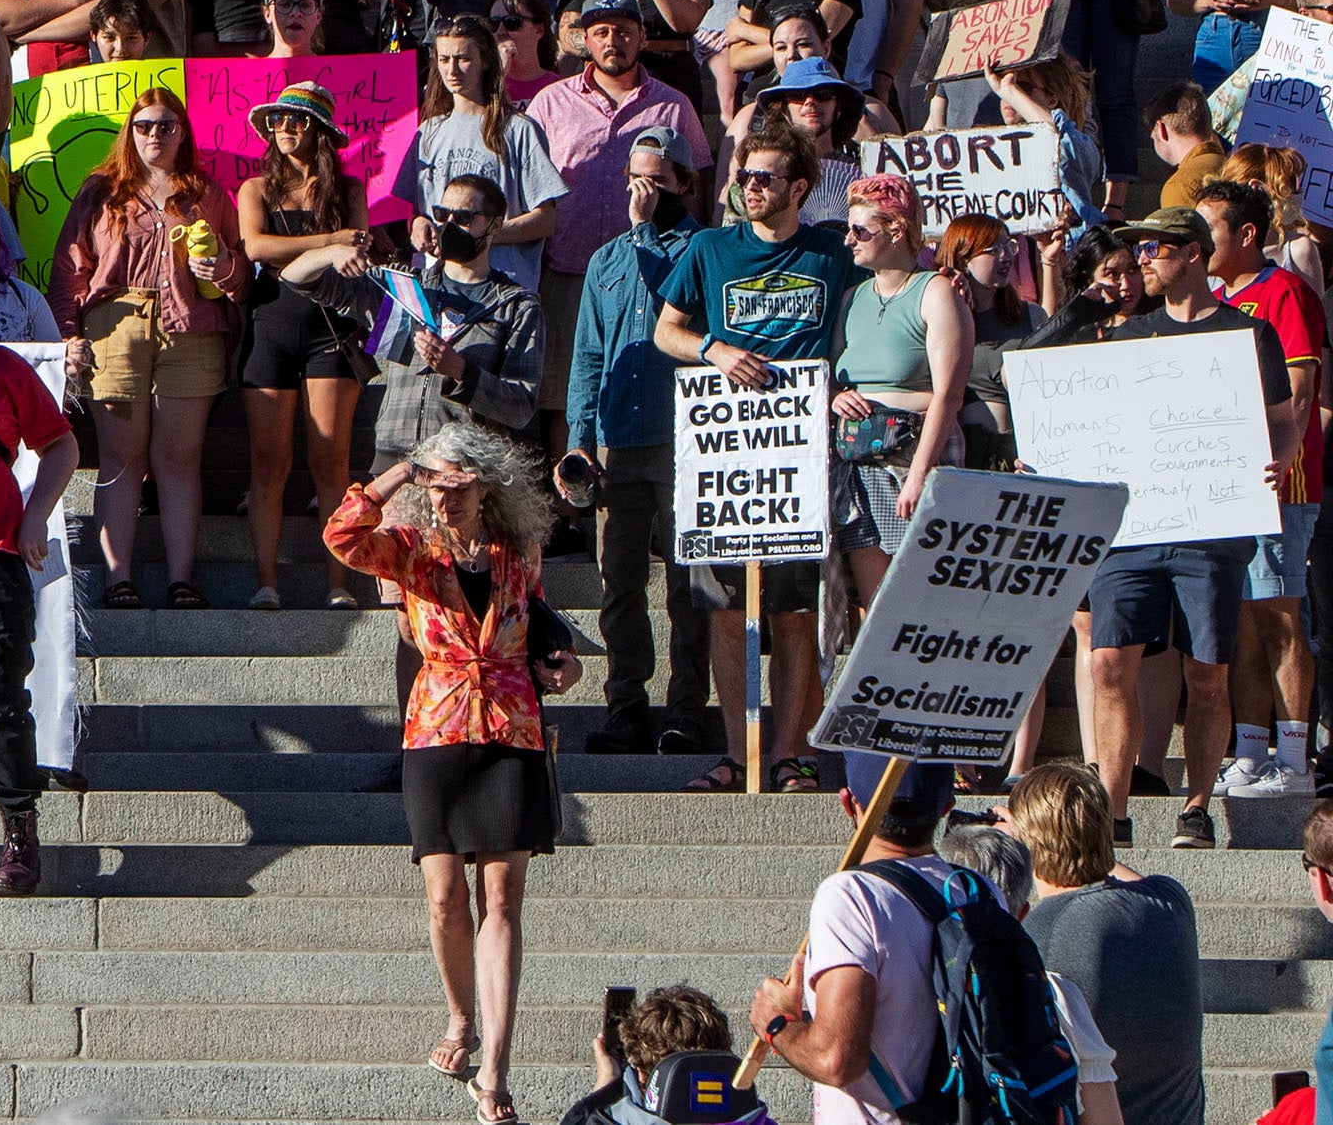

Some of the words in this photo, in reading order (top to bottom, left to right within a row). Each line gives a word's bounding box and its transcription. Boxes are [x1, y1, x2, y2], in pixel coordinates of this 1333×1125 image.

[962, 17, 1031, 53] SAVES
[1248, 68, 1315, 109] FORCED
[876, 131, 1034, 174] ABORT
[689, 404, 733, 426] GO
[738, 395, 812, 422] BACK
[695, 431, 739, 454] WE
[744, 425, 808, 449] WILL
[1154, 436, 1231, 454] Curches
[697, 467, 798, 497] FIGHT
[696, 497, 801, 527] BACK!
[996, 491, 1065, 527] THE
[726, 535, 748, 546] Party
[762, 533, 799, 542] Socialism
[801, 532, 817, 541] and
[768, 544, 822, 554] PSLWEB.ORG
[918, 519, 1069, 564] SYSTEM
[927, 555, 1067, 597] SEXIST!
[892, 623, 981, 662] Fight
[985, 633, 1032, 665] for
[851, 676, 1024, 719] Socialism!
[939, 727, 982, 741] Socialism
[937, 745, 1002, 758] PSLWEB.ORG
